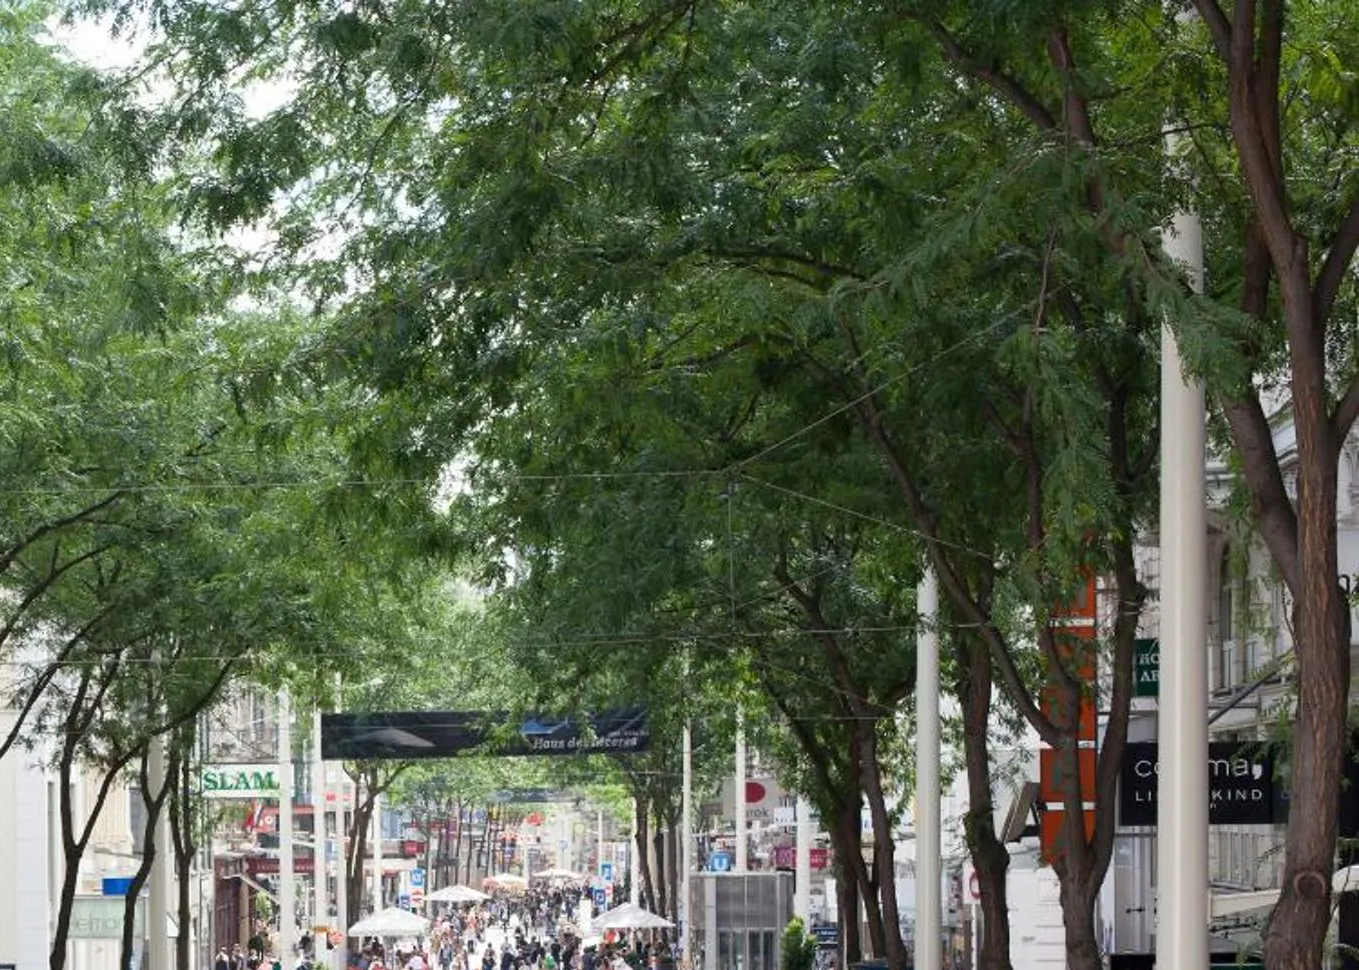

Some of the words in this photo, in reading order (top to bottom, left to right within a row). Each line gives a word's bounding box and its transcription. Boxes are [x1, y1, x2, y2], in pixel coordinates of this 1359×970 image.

[1134, 756, 1264, 780] cma,
[203, 770, 281, 791] SLAM
[1135, 788, 1263, 802] LIKIND
